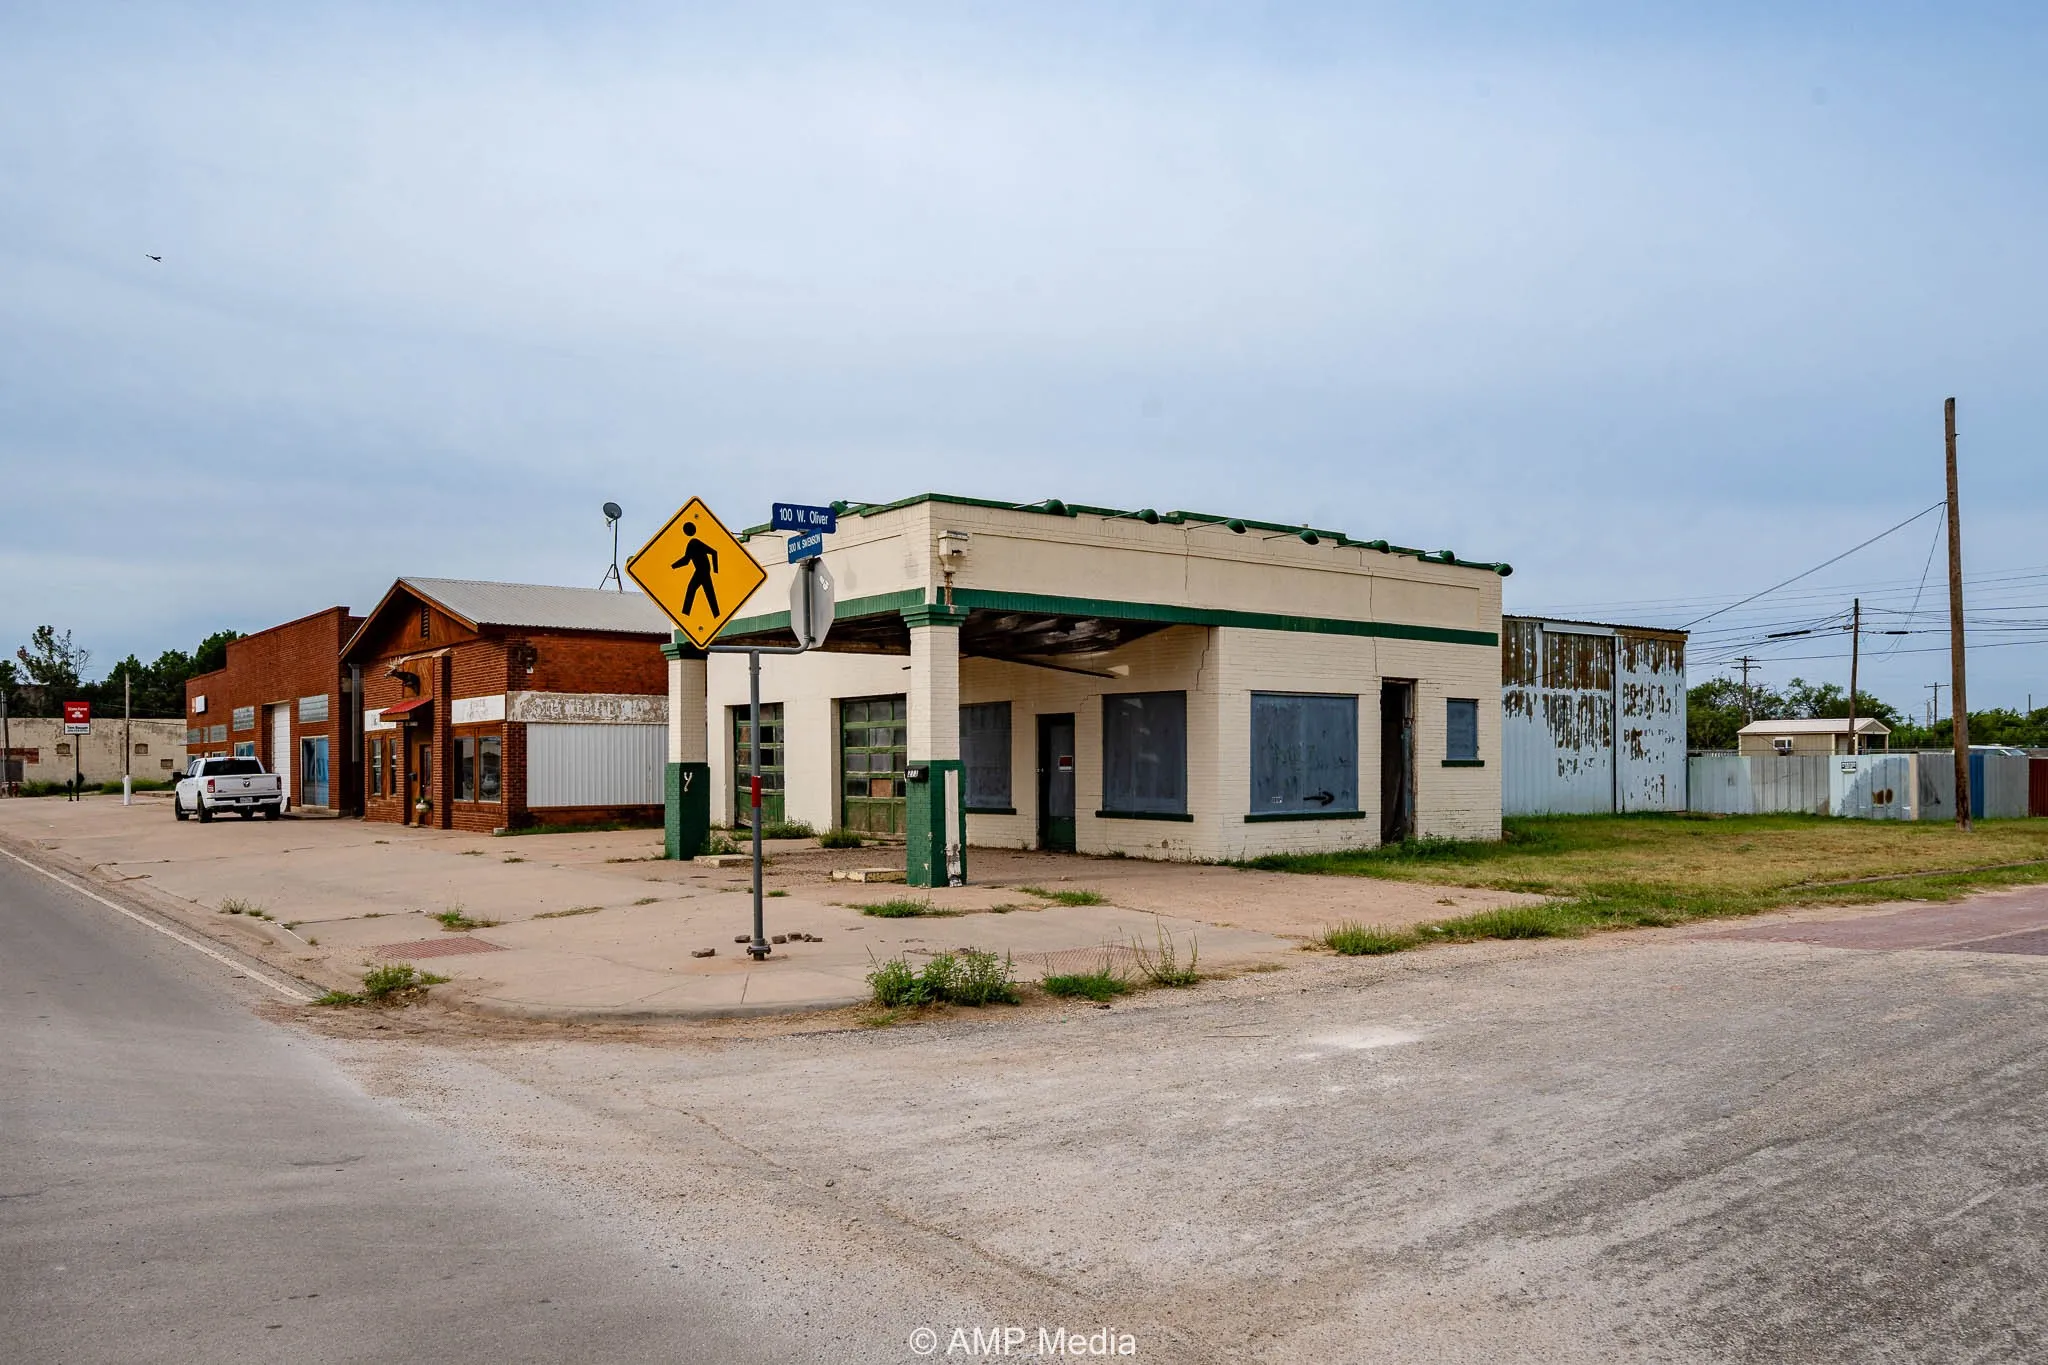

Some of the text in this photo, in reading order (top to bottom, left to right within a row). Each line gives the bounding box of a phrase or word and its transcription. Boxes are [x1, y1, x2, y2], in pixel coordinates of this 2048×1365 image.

[780, 508, 828, 525] 100 W. Oliver
